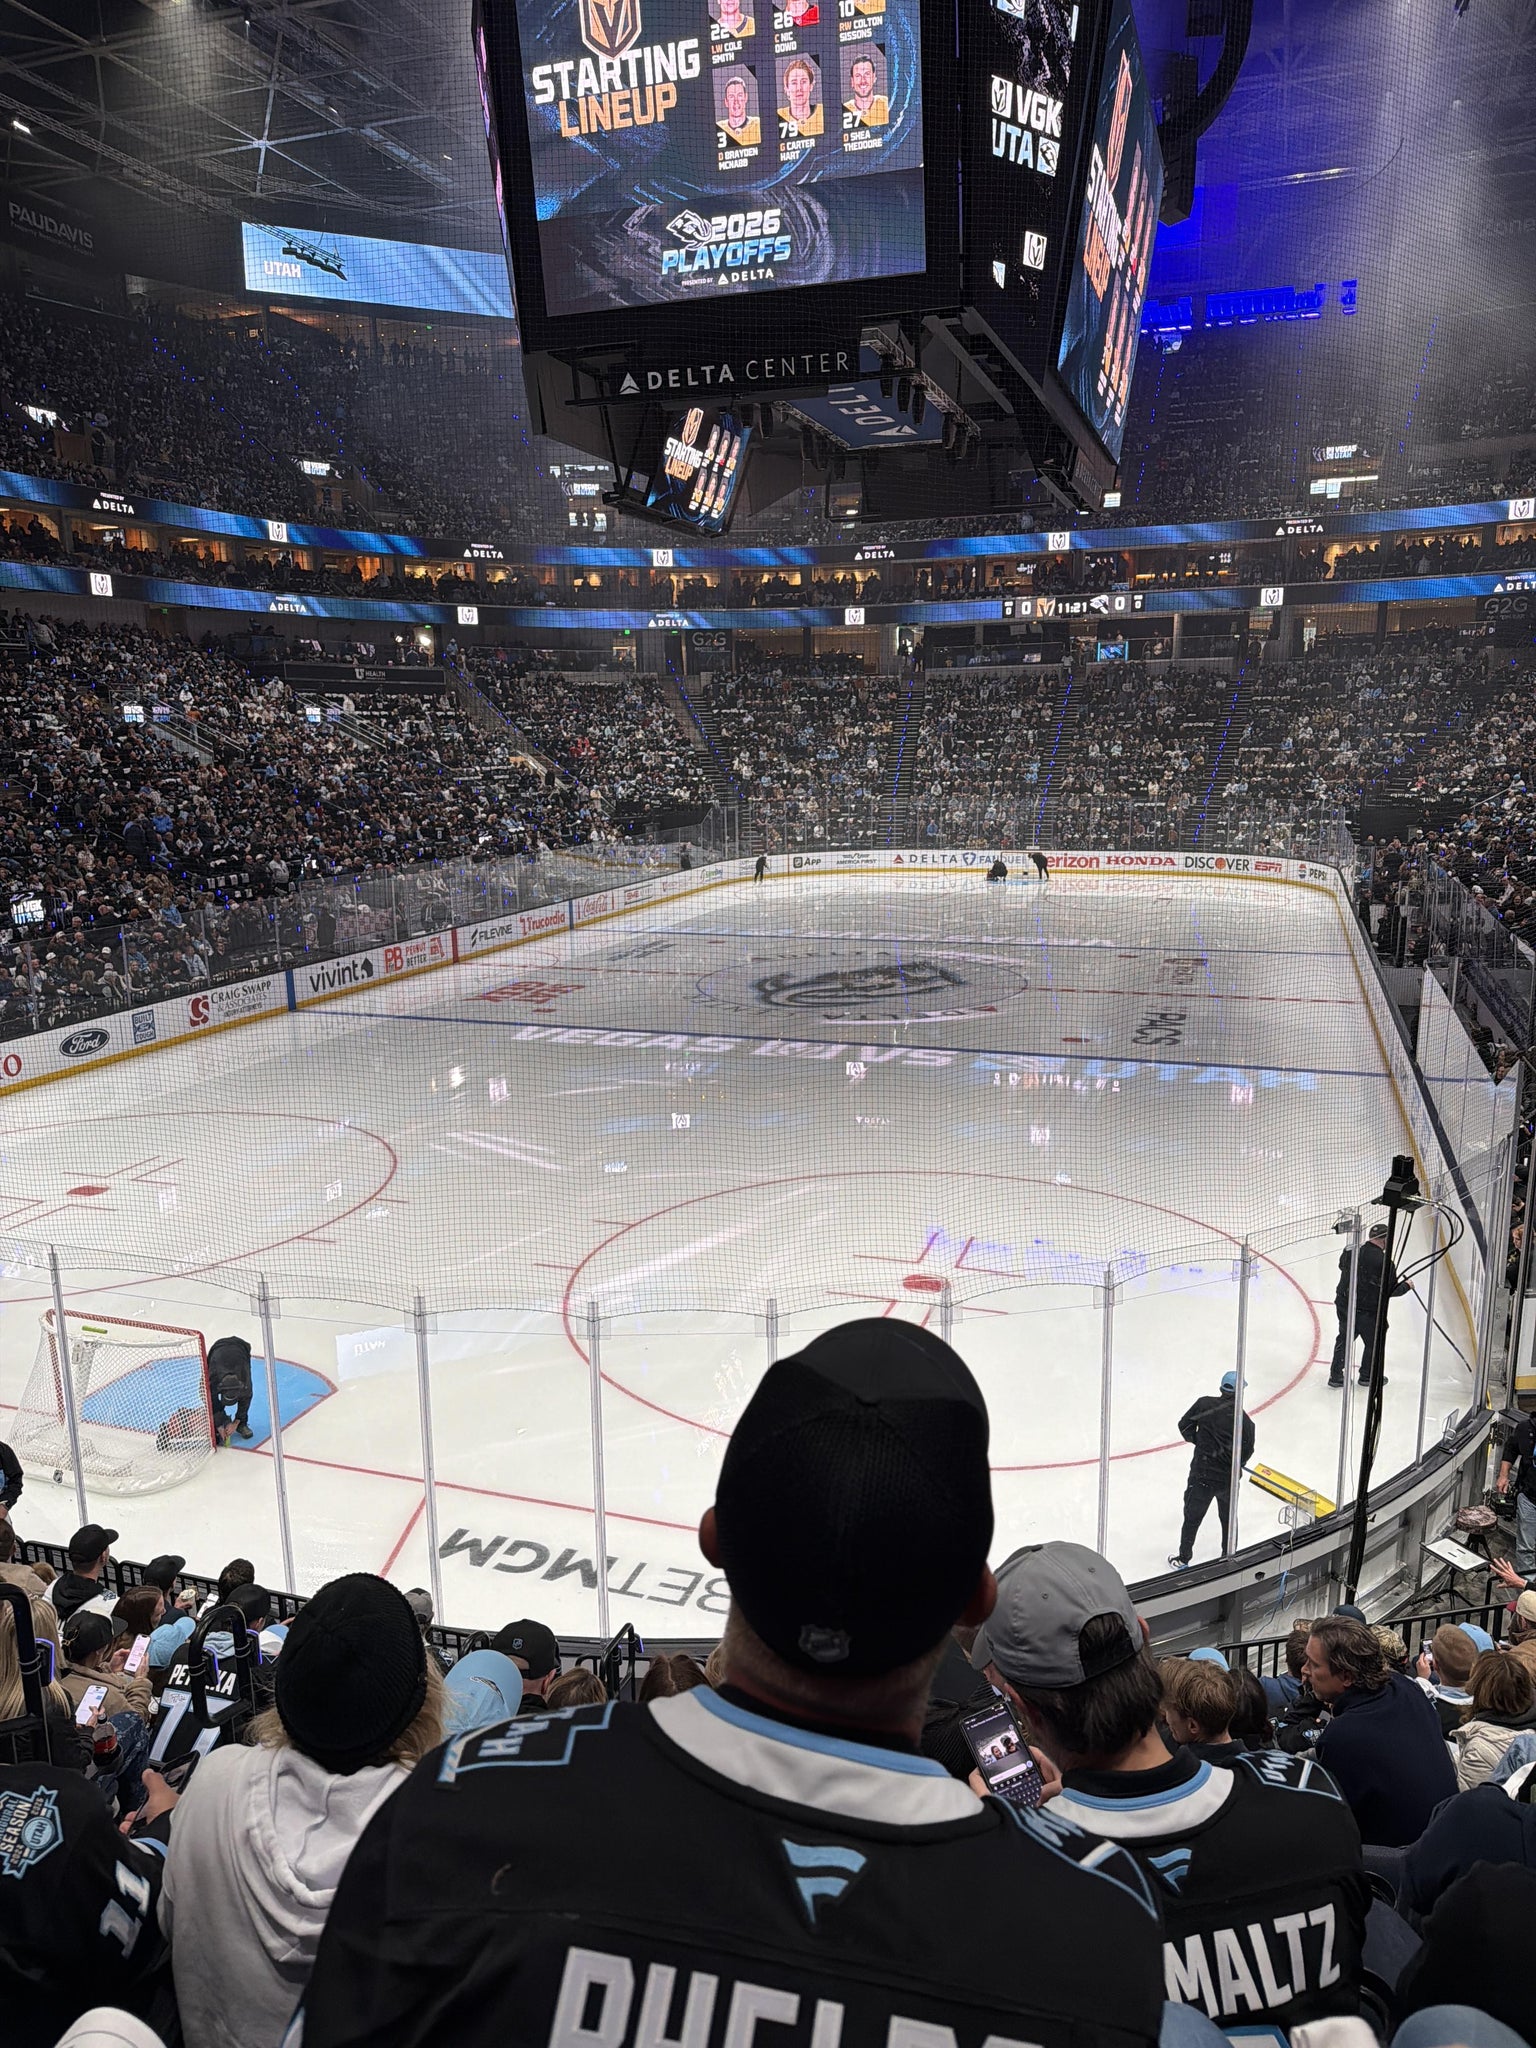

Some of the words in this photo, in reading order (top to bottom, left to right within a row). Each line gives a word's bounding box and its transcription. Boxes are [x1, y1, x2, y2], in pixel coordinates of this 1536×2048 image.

[774, 11, 794, 29] 26
[839, 21, 852, 31] RW
[853, 16, 883, 29] COLTON
[710, 23, 730, 41] 22
[774, 34, 780, 43] C
[781, 32, 794, 41] NIC
[839, 29, 872, 42] SISSONS
[711, 43, 723, 54] LW
[724, 41, 742, 51] COLE
[712, 52, 734, 64] SMITH
[532, 39, 700, 104] STARTING
[559, 83, 677, 138] LINEUP
[1016, 84, 1063, 138] VGK
[843, 111, 861, 128] 27
[779, 122, 798, 138] 79
[843, 134, 849, 142] D
[850, 130, 871, 141] SHEA
[717, 132, 727, 148] 3
[780, 143, 785, 151] G
[786, 139, 815, 150] CARTER
[843, 138, 883, 152] THEODORE
[992, 118, 1033, 169] UTA
[718, 152, 723, 161] D
[725, 148, 758, 160] BRAYDEN
[780, 150, 800, 161] HART
[710, 208, 781, 242] 2026
[661, 235, 792, 275] PLAYOFFS
[263, 260, 302, 279] UTAH
[731, 268, 774, 282] DELTA
[647, 364, 735, 390] DELTA
[746, 352, 849, 380] CENTER
[664, 437, 704, 468] STARTING
[1335, 444, 1358, 452] VEGAS
[1335, 451, 1352, 459] UTAH
[665, 456, 693, 481] LINEUP
[103, 502, 134, 515] DELTA
[1288, 524, 1324, 534] DELTA
[474, 549, 503, 559] DELTA
[864, 550, 895, 560] DELTA
[278, 602, 307, 613] DELTA
[1021, 602, 1031, 615] 0
[1058, 602, 1087, 614] 11:21
[1114, 597, 1125, 610] 0
[1484, 597, 1528, 614] G2G
[658, 618, 689, 627] DELTA
[692, 631, 727, 646] G2G
[910, 854, 957, 863] DELTA
[1047, 854, 1099, 868] erizon
[1106, 855, 1176, 866] HONDA
[1184, 856, 1249, 871] DISCOVER
[1254, 861, 1282, 873] ESPN
[526, 910, 565, 932] Trucordia
[479, 924, 513, 941] FILEVINE
[407, 954, 427, 967] BETTER
[310, 962, 361, 993] vivint
[211, 988, 240, 1003] CRAIG
[242, 981, 271, 996] SWAPP
[224, 992, 267, 1010] ASSOCIATES
[134, 1013, 152, 1024] BUILT
[69, 1033, 101, 1053] Ford
[135, 1031, 153, 1040] TOUGH
[512, 1024, 737, 1053] VEGAS
[0, 1800, 32, 1853] SEASON
[31, 1821, 48, 1845] UTAH
